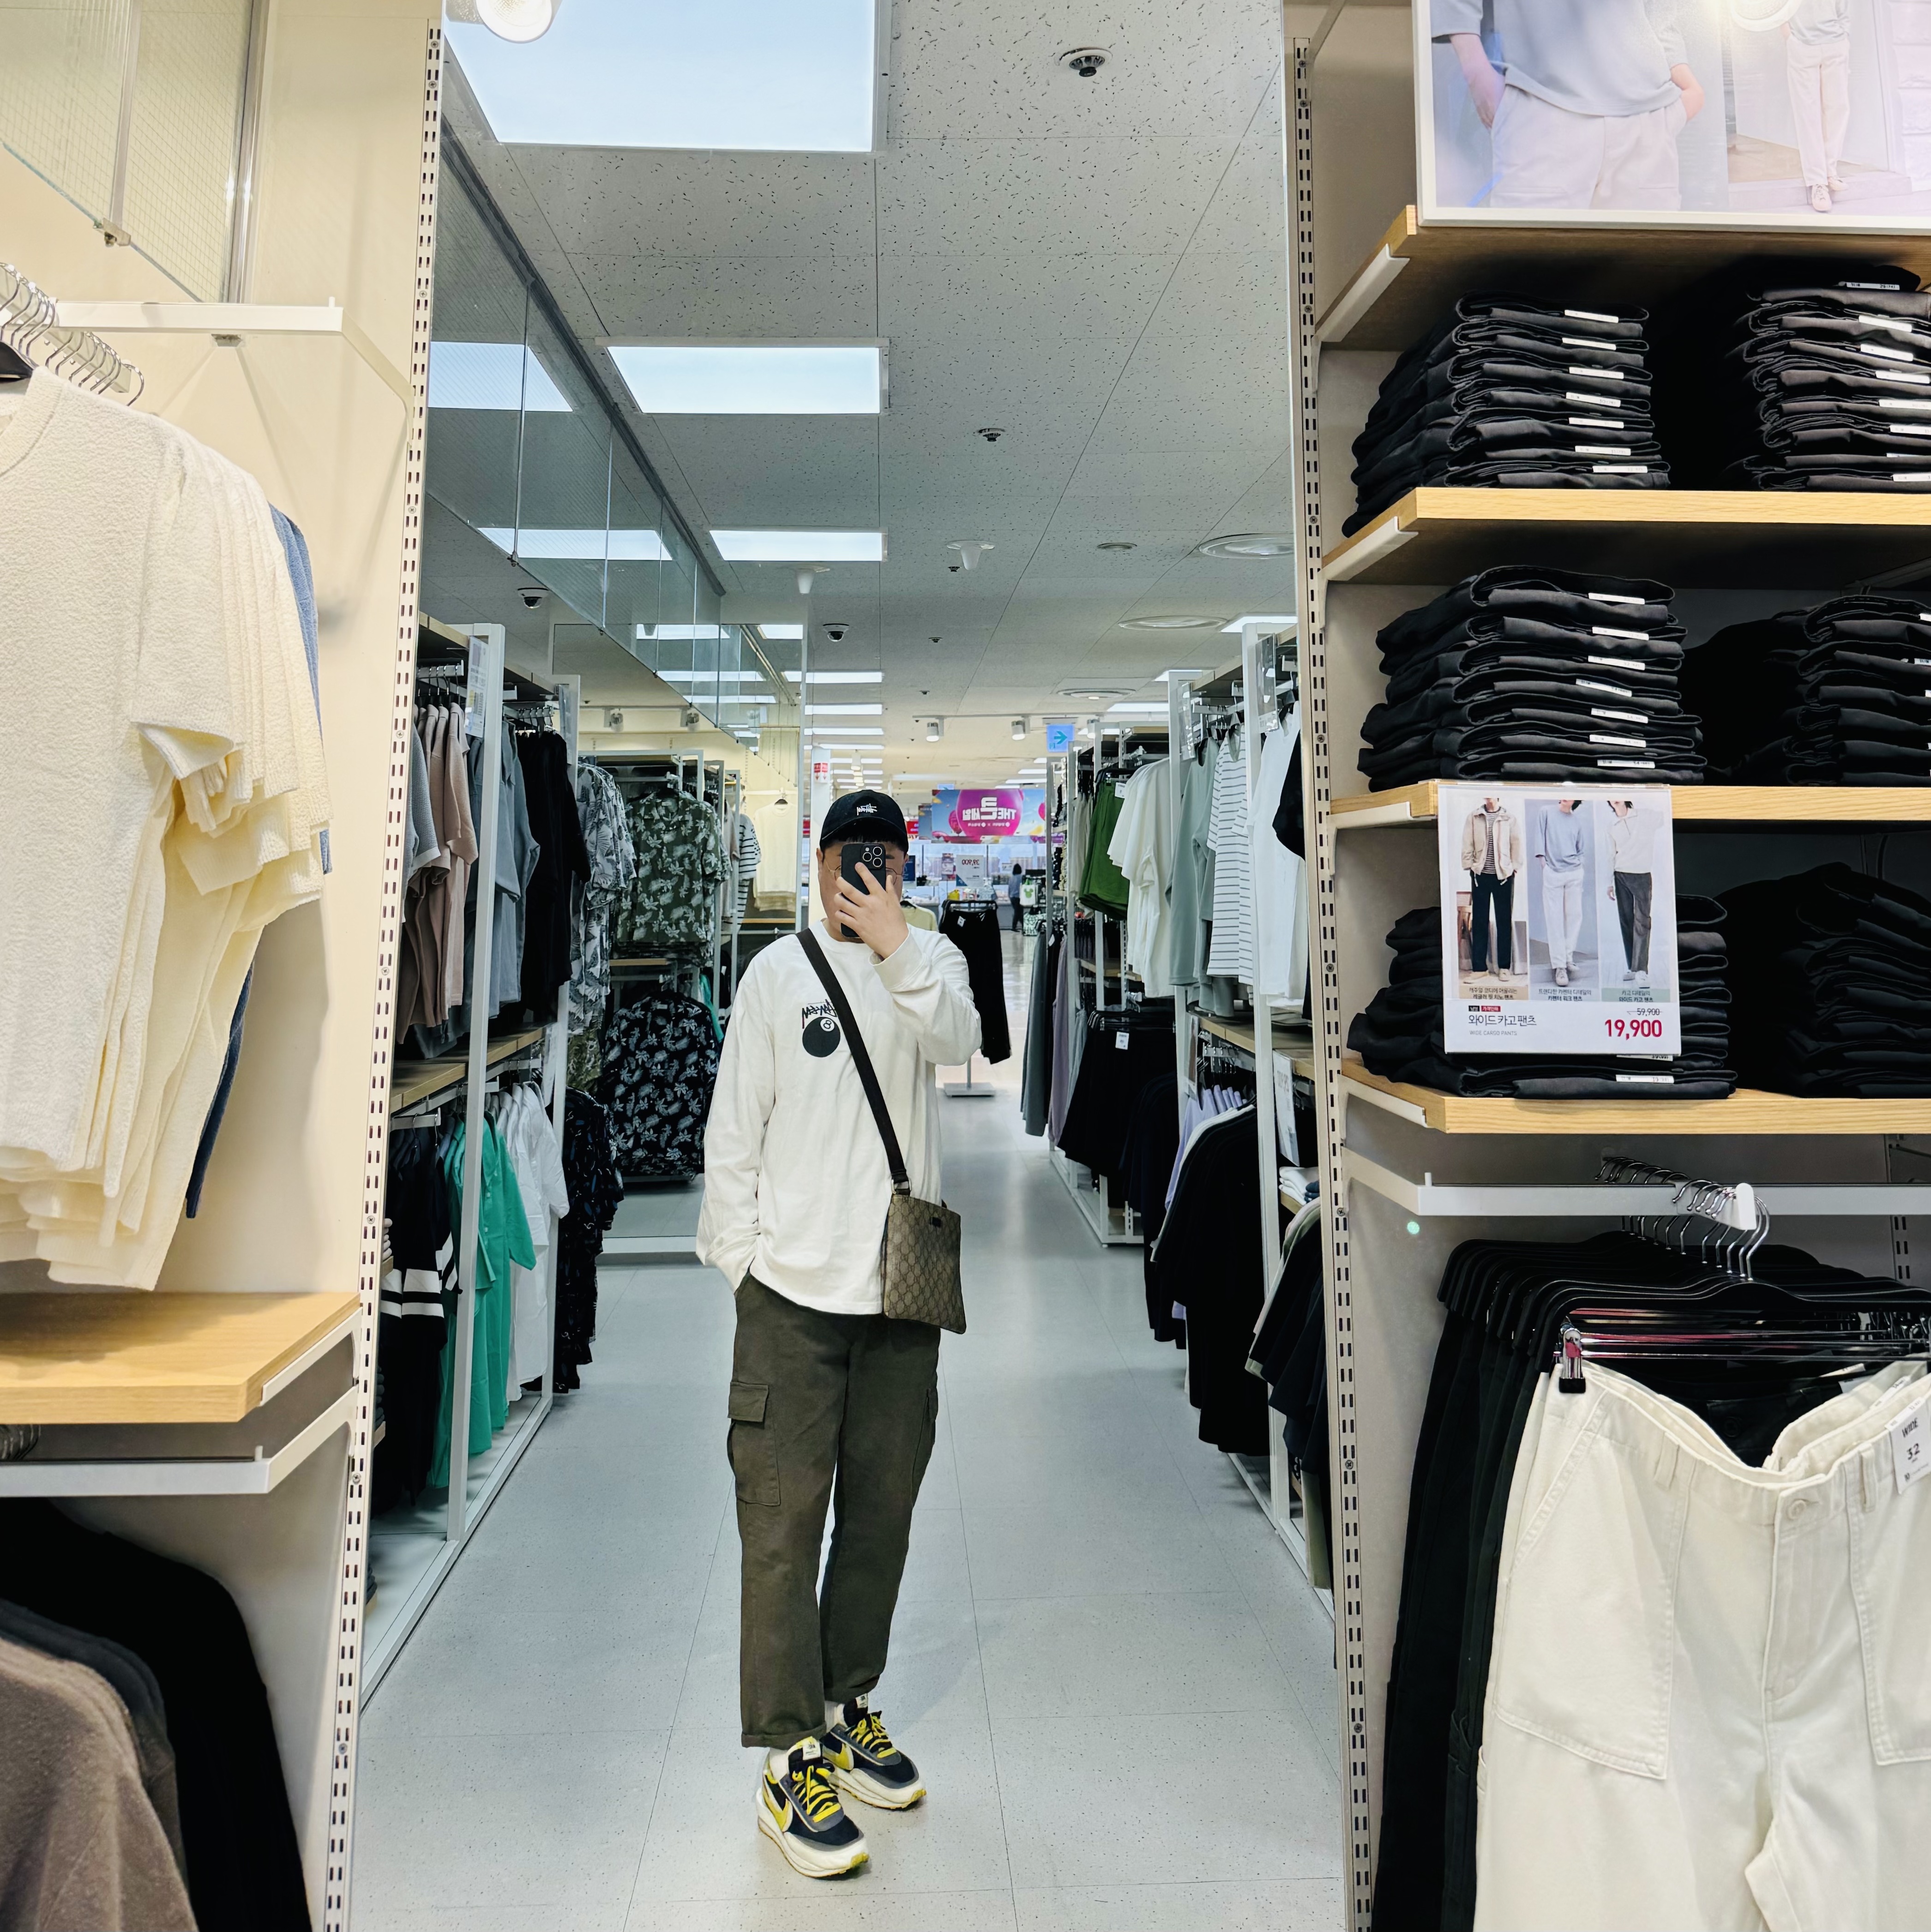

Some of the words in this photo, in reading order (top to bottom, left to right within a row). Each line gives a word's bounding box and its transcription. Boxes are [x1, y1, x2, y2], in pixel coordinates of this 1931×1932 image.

[1468, 1015, 1497, 1026] 와이드
[1498, 1015, 1517, 1026] 카고
[1517, 1015, 1537, 1027] 팬츠
[1636, 1008, 1660, 1017] 59,900
[1605, 1019, 1662, 1041] 19,900
[1901, 1417, 1919, 1438] WIDE
[1907, 1443, 1920, 1460] 32
